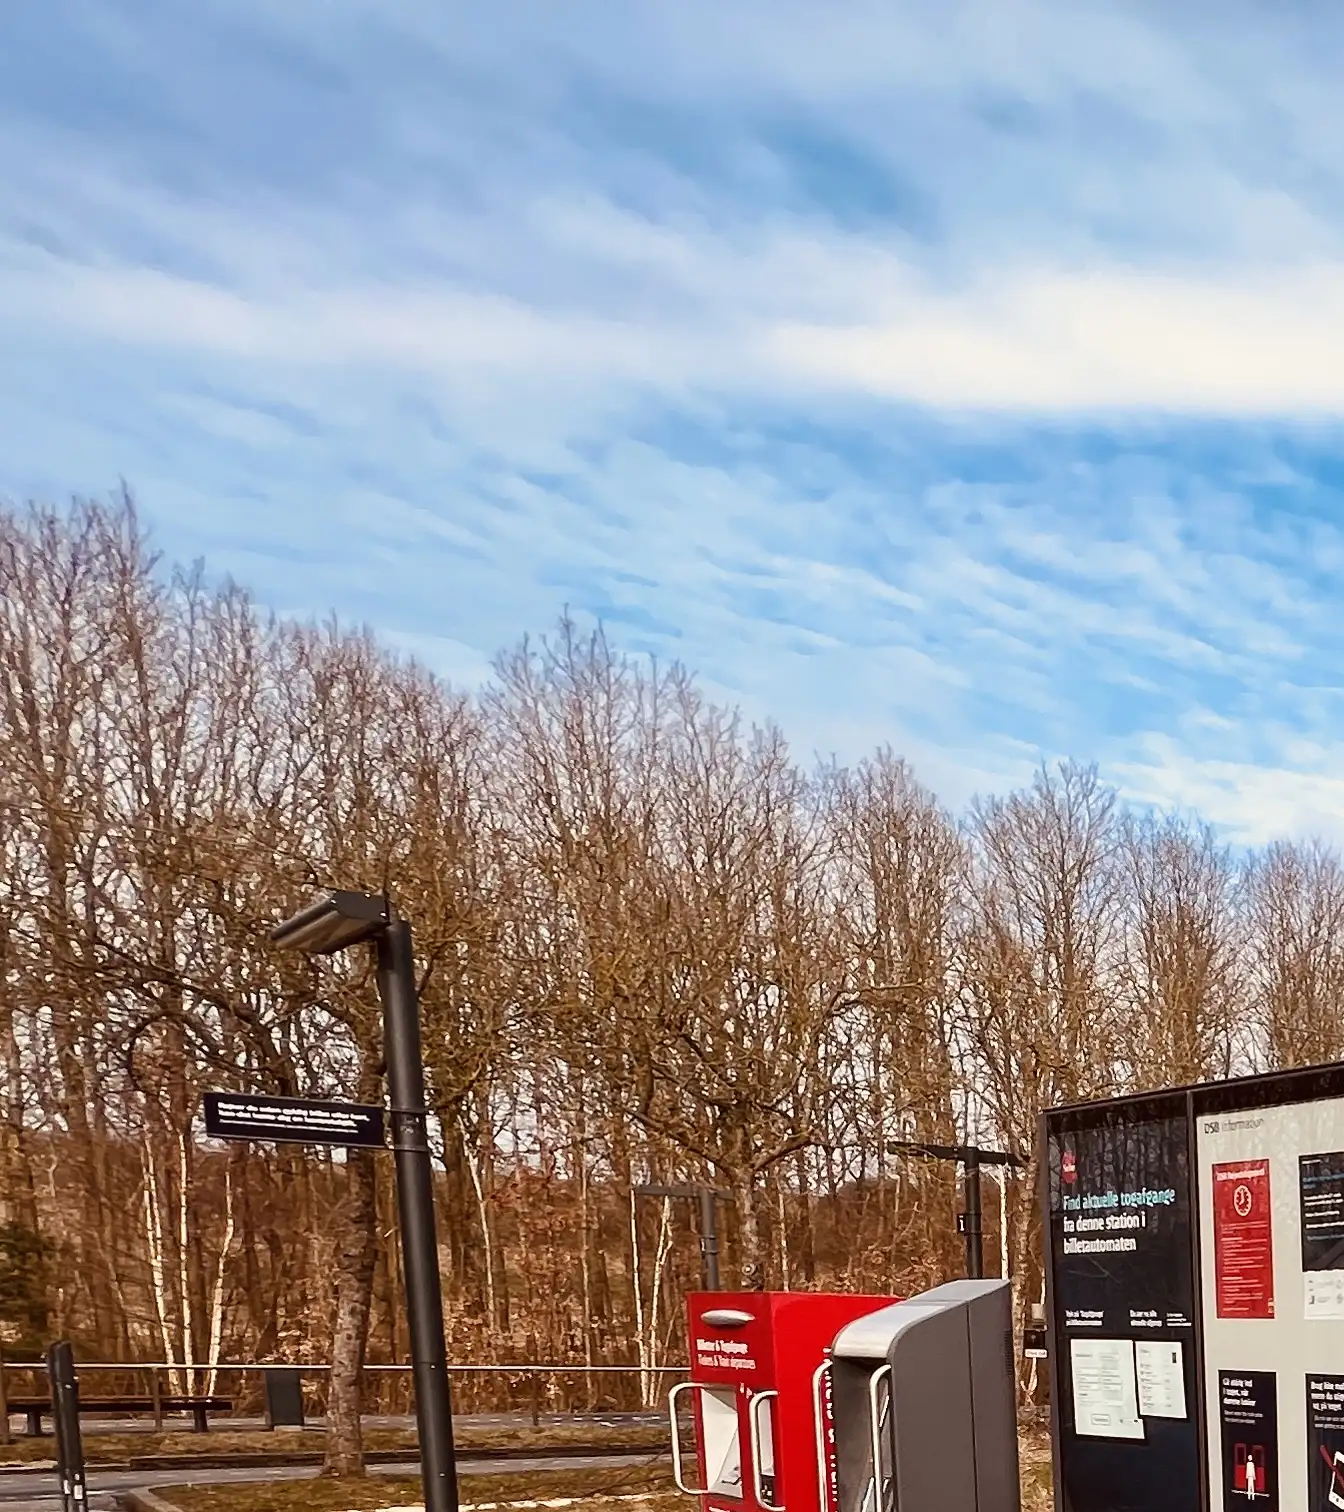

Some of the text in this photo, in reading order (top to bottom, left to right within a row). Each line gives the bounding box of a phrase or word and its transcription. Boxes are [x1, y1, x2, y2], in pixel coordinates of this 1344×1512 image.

[1204, 1121, 1220, 1134] DSB
[1063, 1187, 1175, 1210] Find aktuelle togafgange
[1063, 1211, 1146, 1233] fra denne station i
[1063, 1237, 1137, 1254] billetautomaten
